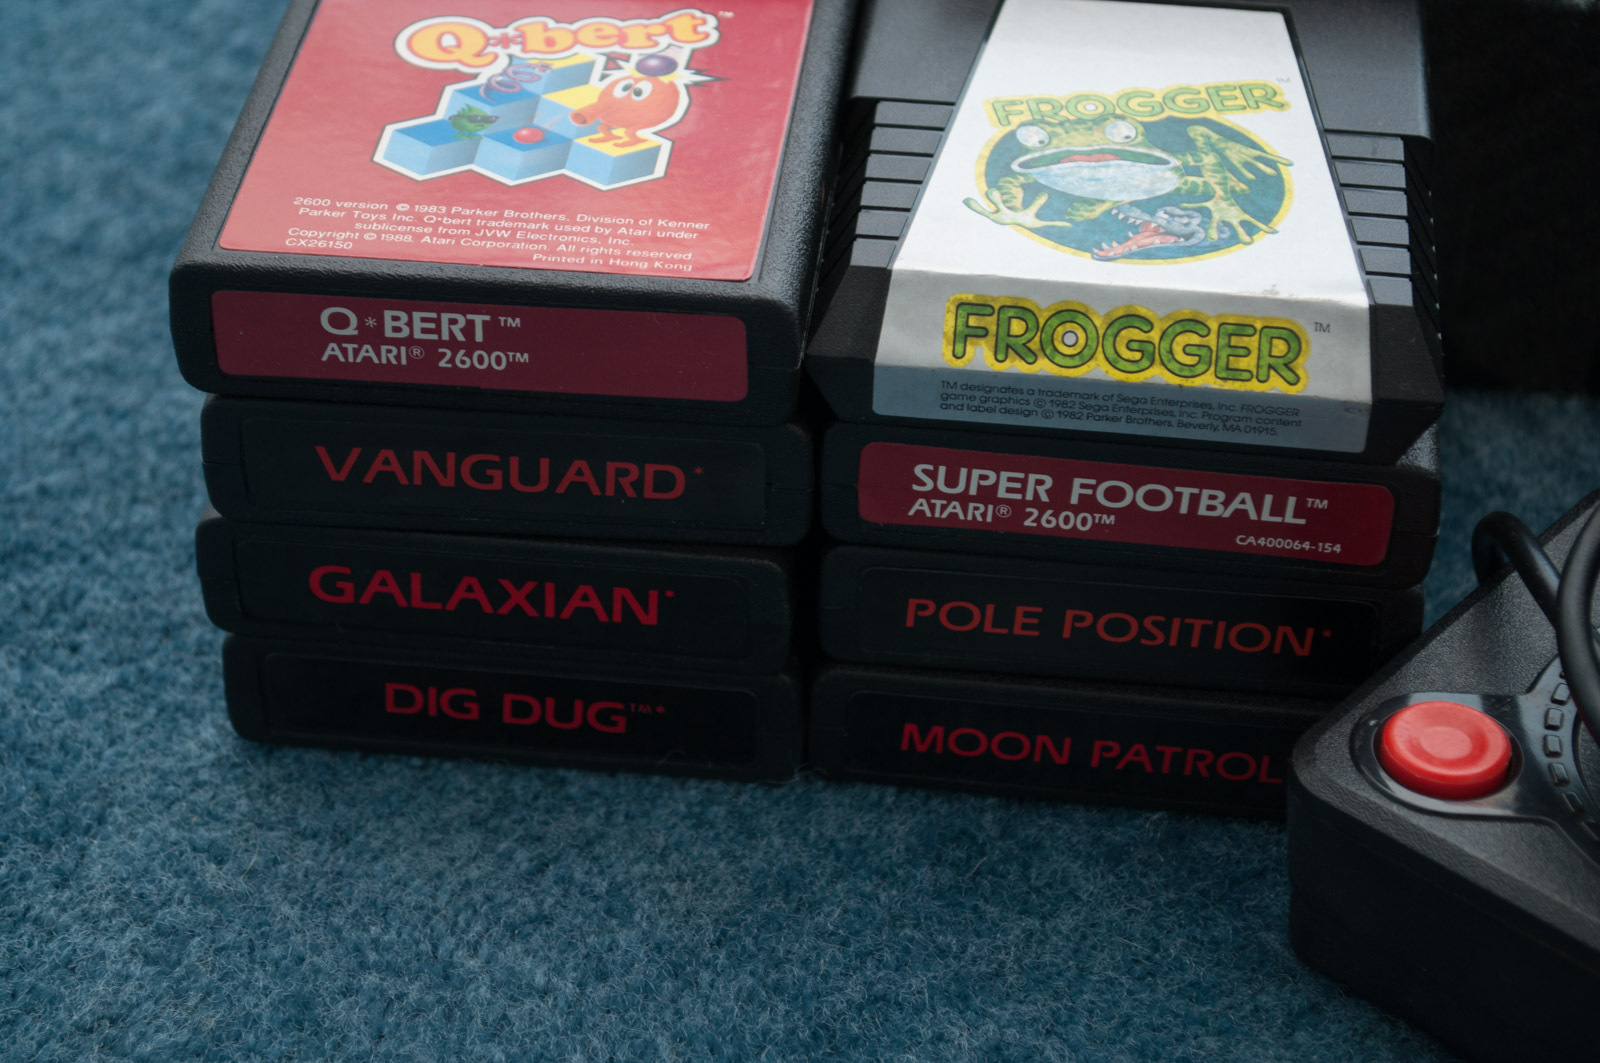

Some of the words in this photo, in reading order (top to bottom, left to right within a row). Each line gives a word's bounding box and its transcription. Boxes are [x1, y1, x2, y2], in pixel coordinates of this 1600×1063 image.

[991, 83, 1287, 127] FROGGER
[293, 197, 331, 207] 2600
[336, 200, 389, 210] version
[414, 204, 447, 214] 1983
[451, 206, 498, 217] Parker
[576, 213, 634, 225] Division
[638, 217, 653, 227] of
[657, 218, 710, 230] Kenner
[298, 207, 347, 218] Parker
[352, 210, 387, 221] Toys
[392, 213, 418, 222] Inc.
[477, 217, 550, 230] trademark
[554, 223, 591, 233] used
[594, 225, 612, 235] by
[617, 226, 652, 236] Atari
[657, 229, 699, 239] under
[285, 238, 353, 249] CX26150
[288, 227, 359, 240] Copyright
[420, 236, 455, 245] Atari
[556, 243, 576, 252] All
[580, 246, 622, 256] rights
[626, 249, 695, 260] reserved.
[354, 222, 433, 233] sublicense
[438, 225, 471, 236] from
[475, 228, 511, 238] JVW
[608, 236, 634, 246] Inc.
[533, 254, 585, 264] Printed
[590, 256, 603, 265] in
[609, 258, 648, 269] Hong
[654, 261, 692, 272] Kong
[952, 302, 1302, 386] FROGGER
[940, 391, 976, 403] game
[979, 393, 1031, 406] graphics
[1050, 399, 1076, 409] 1982
[1078, 402, 1109, 413] Sega
[1112, 405, 1176, 418] Enterprises,
[1178, 409, 1198, 419] Inc.
[1202, 410, 1253, 424] Program
[1255, 416, 1302, 427] content
[941, 380, 958, 390] TM
[960, 382, 1024, 395] designates
[1027, 388, 1035, 396] a
[1038, 388, 1100, 401] trademark
[1103, 393, 1115, 402] of
[1117, 394, 1148, 405] Sega
[1151, 396, 1215, 410] Enterprises,
[1217, 402, 1237, 412] Inc.
[1241, 403, 1300, 416] FROGGER
[940, 402, 964, 411] and
[967, 403, 997, 414] label
[999, 405, 1038, 417] design
[1057, 410, 1084, 421] 1982
[1086, 412, 1122, 423] Parker
[1177, 419, 1220, 432] Beverly,
[1222, 423, 1242, 433] MA
[911, 463, 1054, 504] SUPER
[1236, 534, 1342, 555] CA400064-154
[905, 598, 1043, 637] POLE
[385, 683, 480, 720] DIG
[900, 723, 1072, 765] MOON
